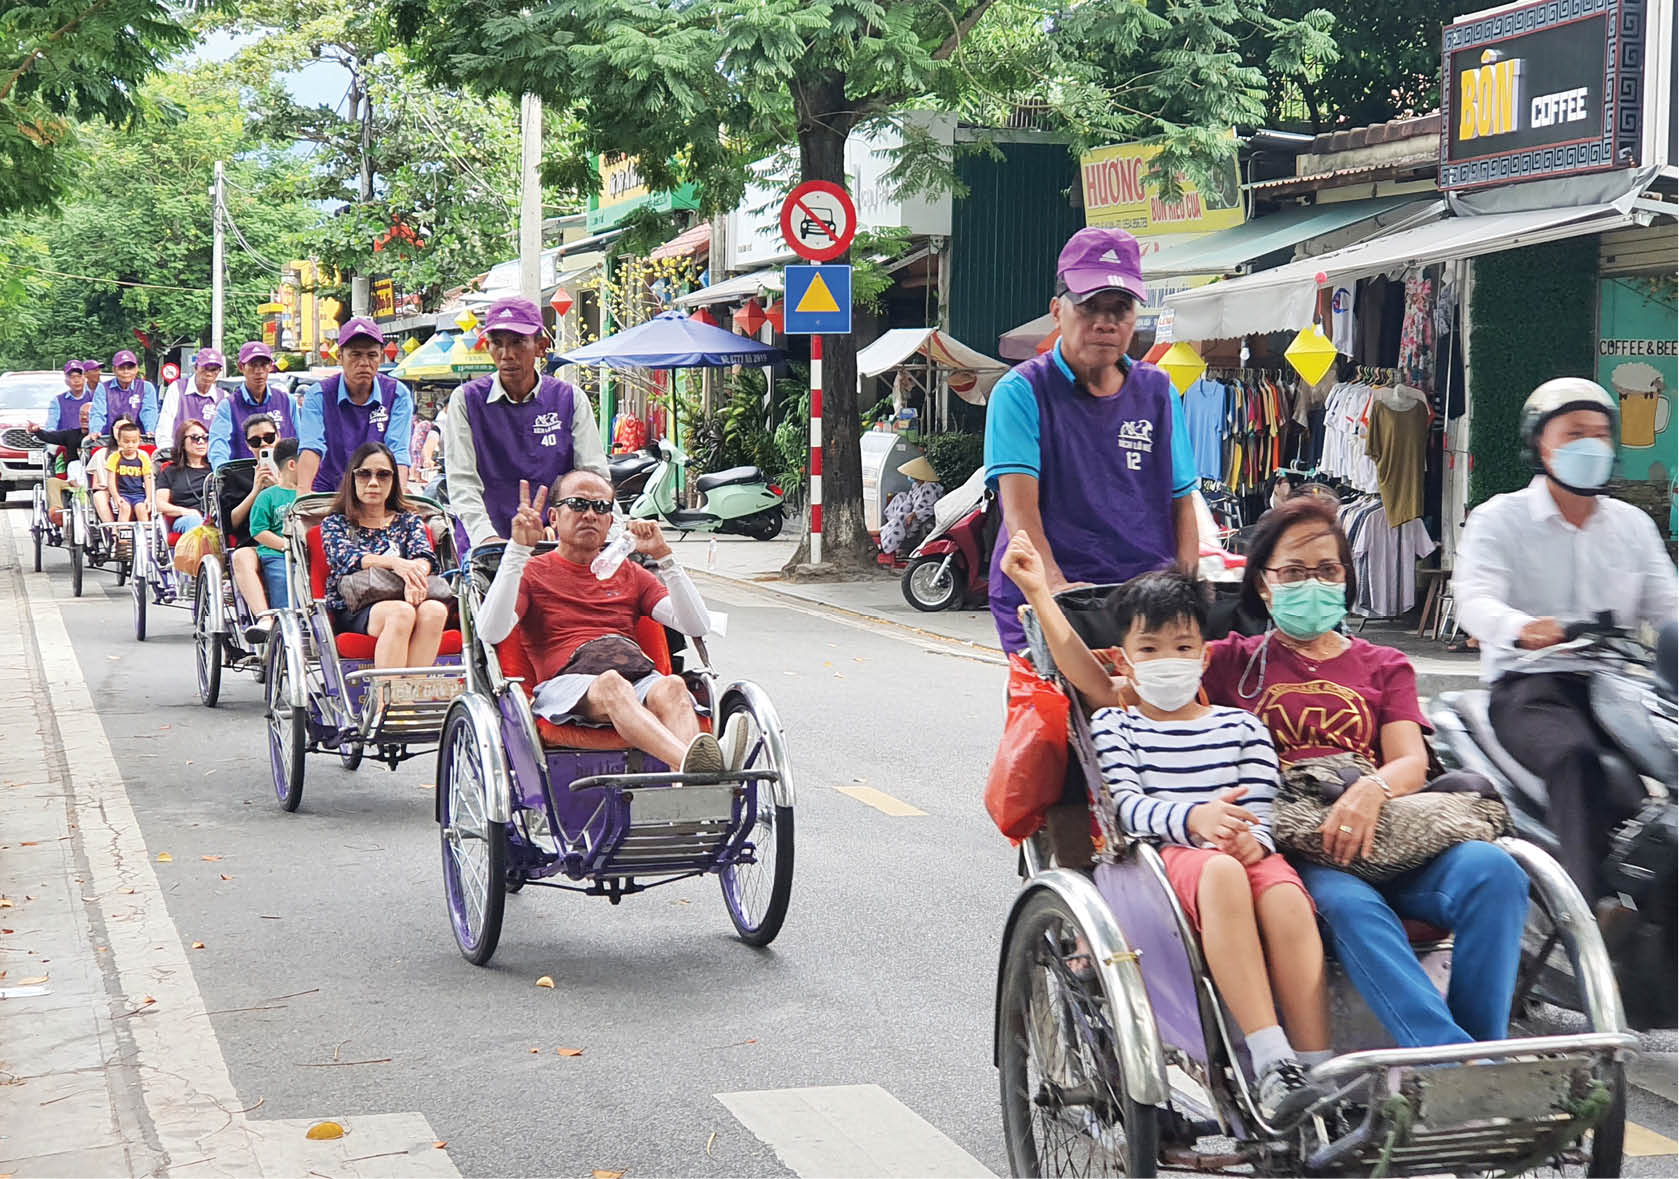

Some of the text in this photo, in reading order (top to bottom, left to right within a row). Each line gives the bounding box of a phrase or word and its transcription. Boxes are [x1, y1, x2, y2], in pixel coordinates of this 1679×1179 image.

[1531, 87, 1588, 129] COFFEE
[1085, 156, 1145, 207] HƯƠNG
[541, 433, 557, 447] 40
[1126, 451, 1142, 471] 12
